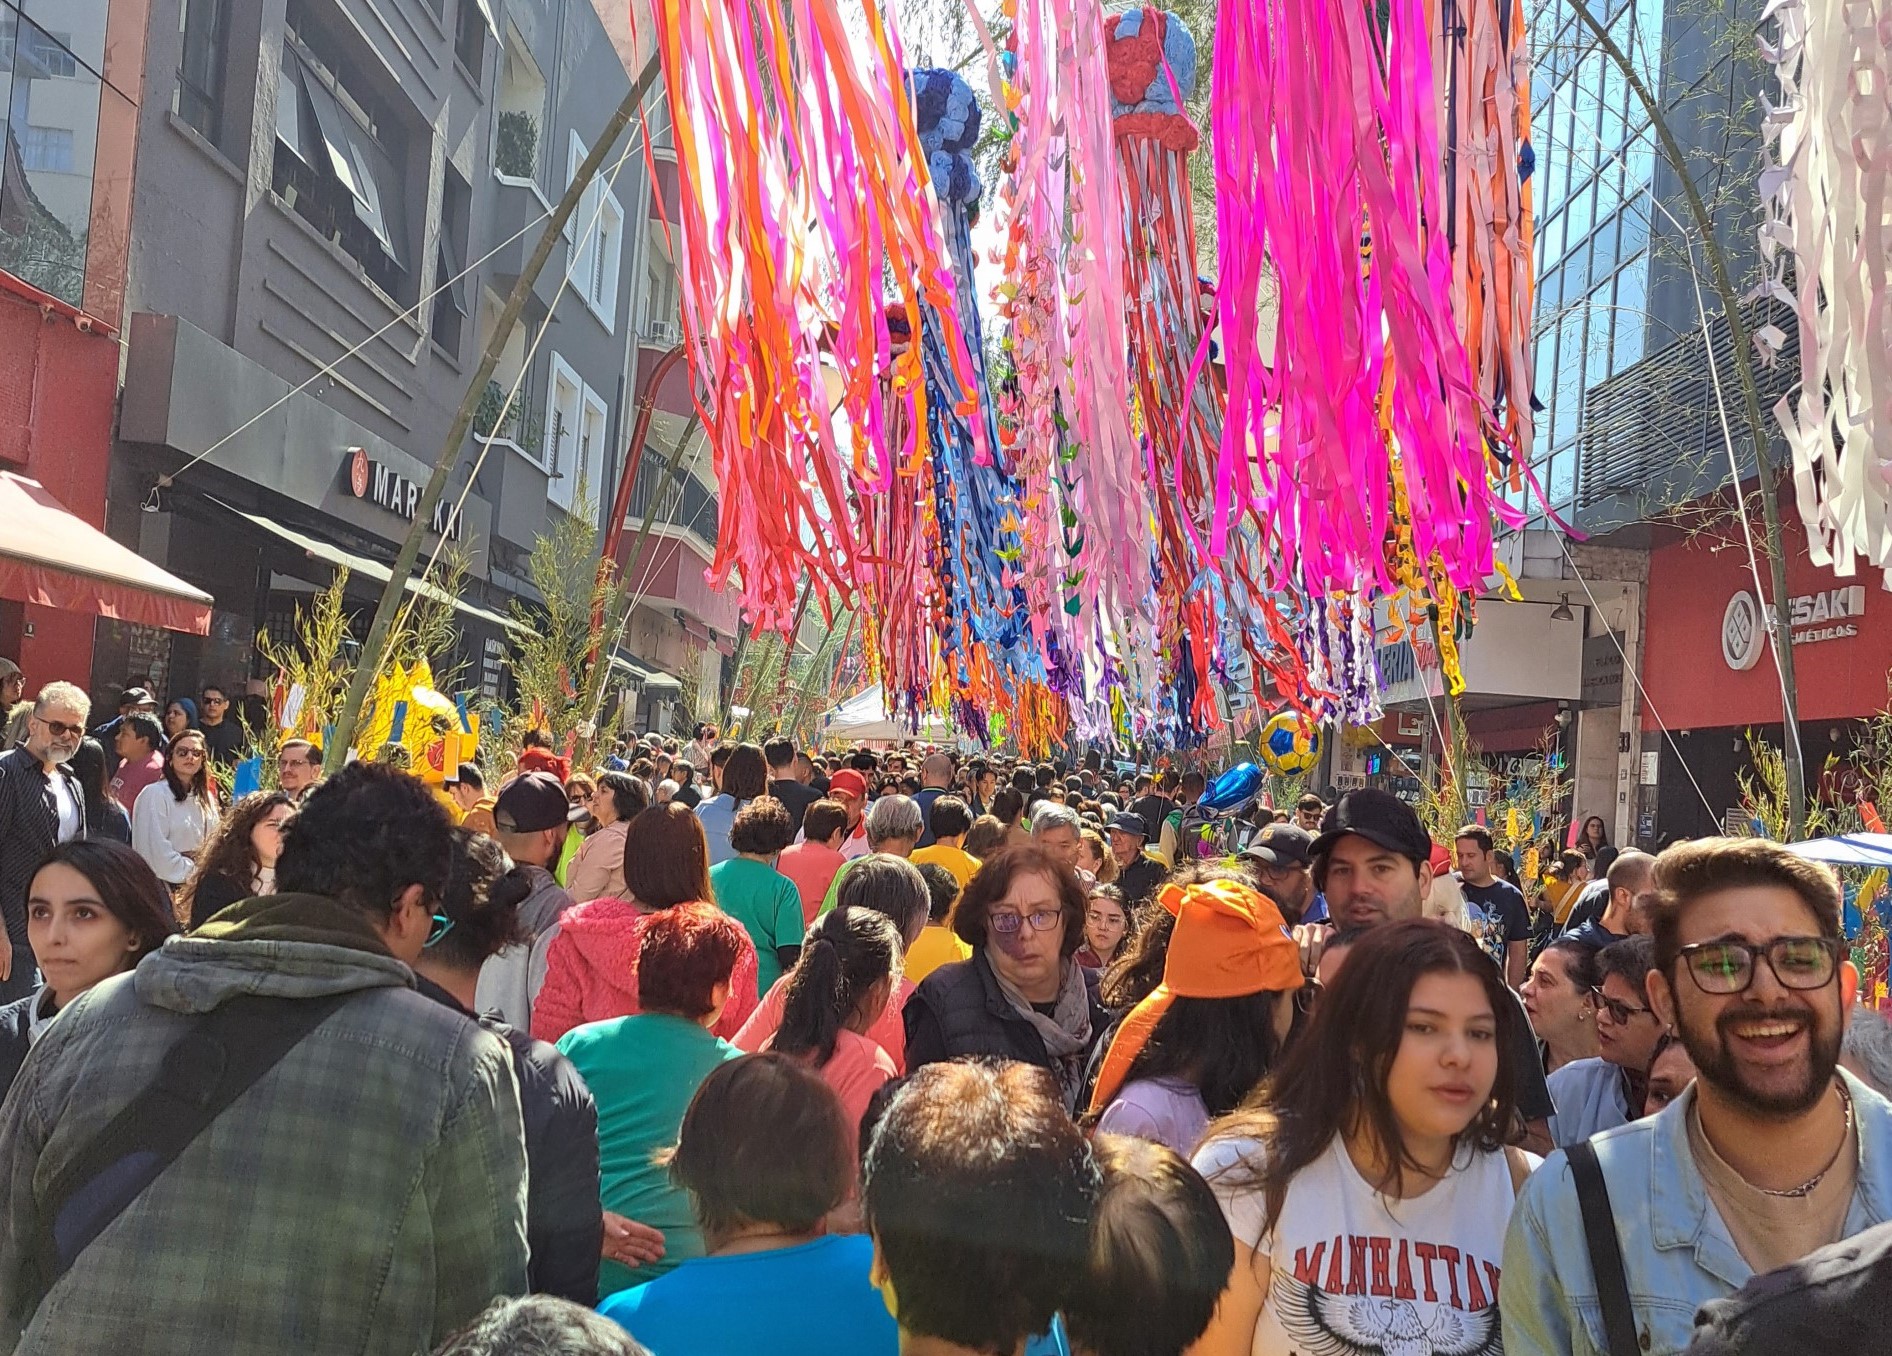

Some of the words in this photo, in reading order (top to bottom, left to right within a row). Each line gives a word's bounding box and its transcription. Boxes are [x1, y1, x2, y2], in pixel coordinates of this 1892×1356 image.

[374, 462, 463, 542] MARKAI
[1761, 586, 1866, 631] SAKI
[1293, 1235, 1501, 1312] MANHATTAN
